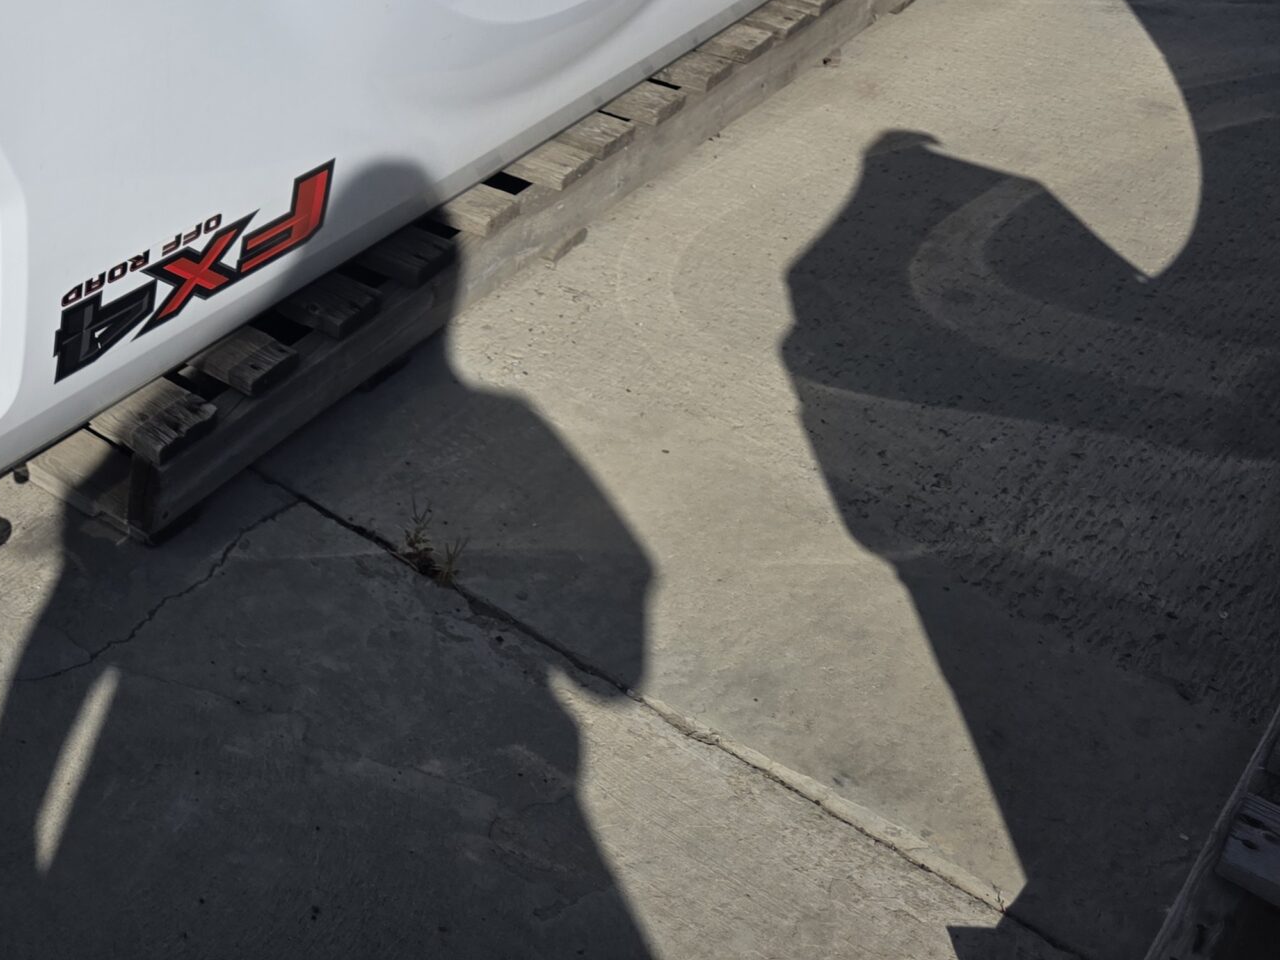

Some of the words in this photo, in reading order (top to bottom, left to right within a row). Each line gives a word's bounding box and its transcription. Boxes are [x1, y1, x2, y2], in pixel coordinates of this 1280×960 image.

[161, 213, 223, 257] OFF
[53, 157, 336, 384] FX4
[60, 249, 150, 308] ROAD
